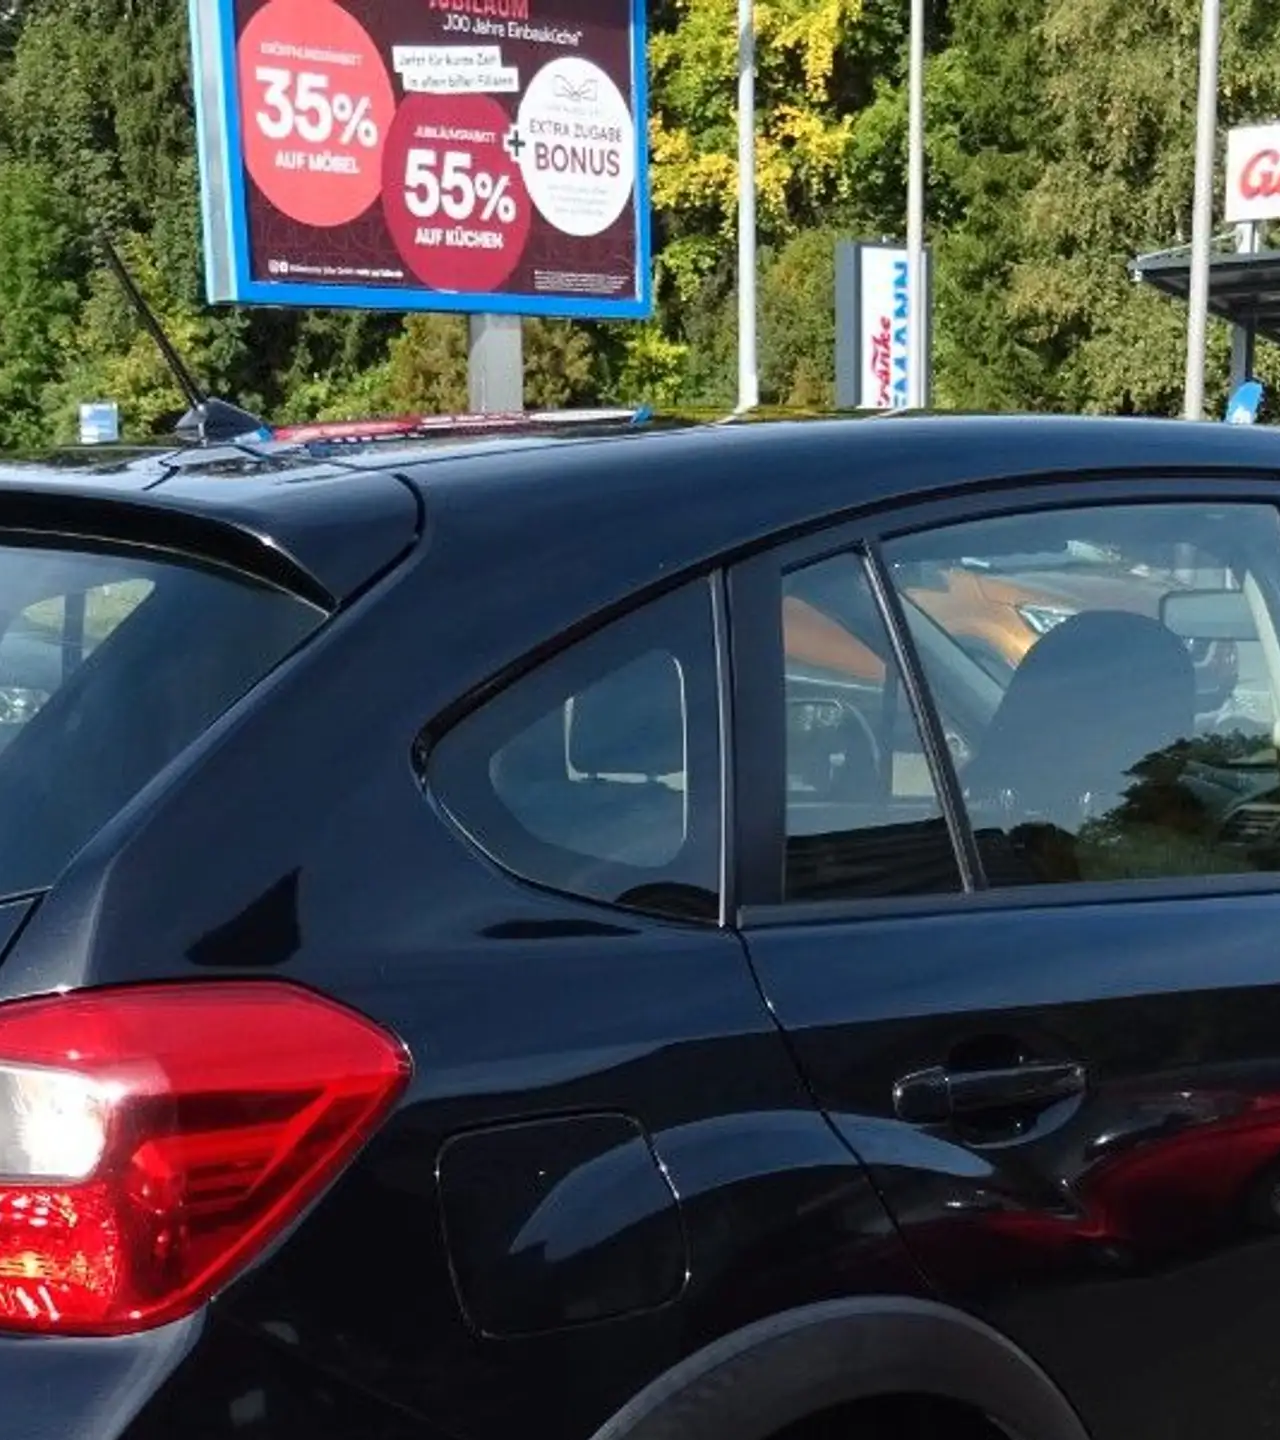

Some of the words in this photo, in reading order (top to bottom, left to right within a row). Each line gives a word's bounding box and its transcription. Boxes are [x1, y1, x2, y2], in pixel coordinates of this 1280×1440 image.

[473, 18, 504, 37] Jahre
[256, 66, 378, 148] 35%
[529, 118, 570, 136] EXTRA
[574, 122, 622, 143] ZUGABE
[275, 149, 307, 171] AUF
[308, 150, 360, 174] MÖBEL
[534, 141, 620, 177] BONUS
[404, 148, 517, 224] 55%
[414, 227, 443, 246] AUF
[445, 225, 504, 249] KÜCHEN
